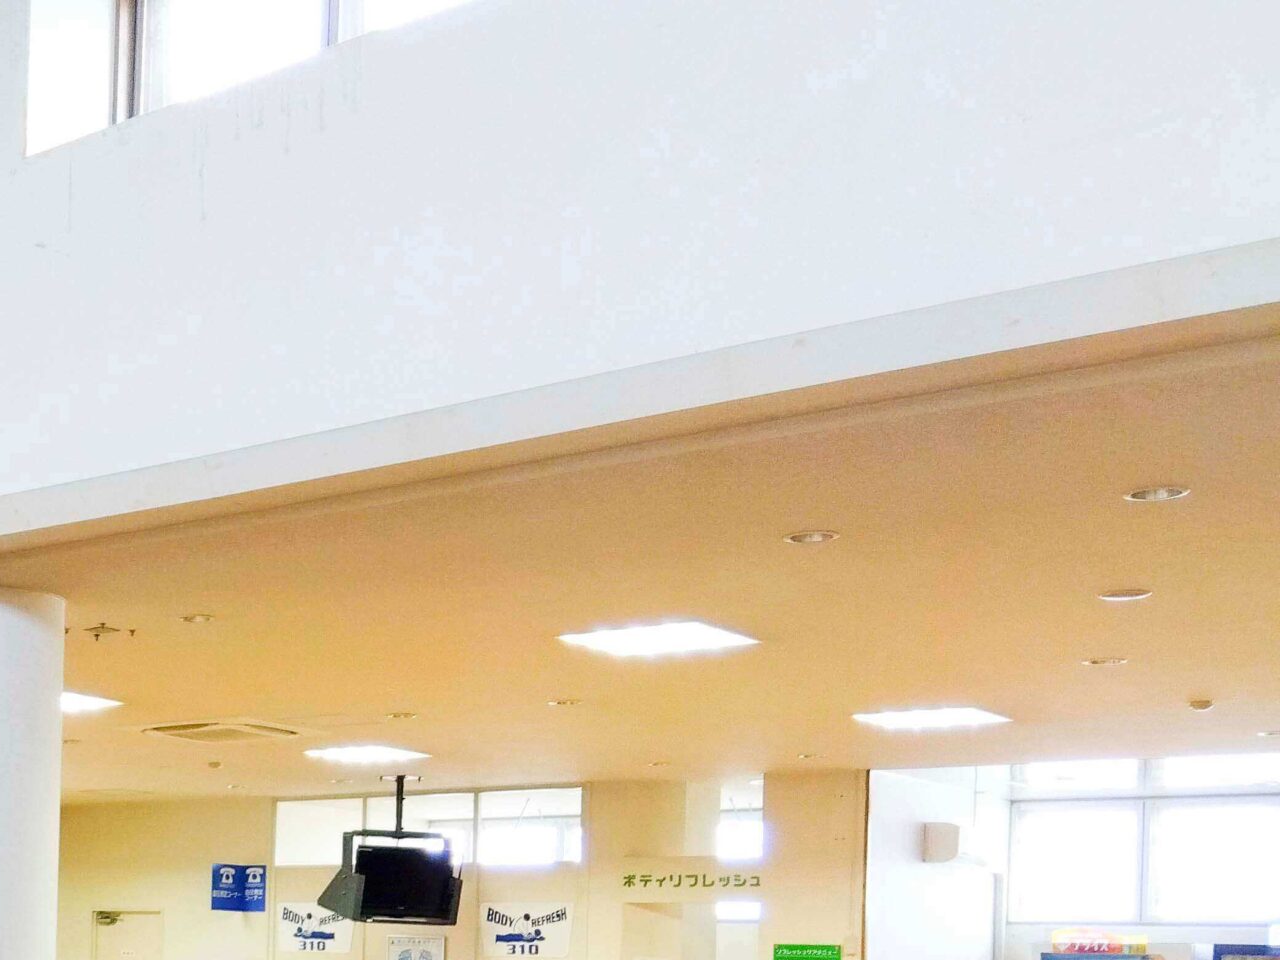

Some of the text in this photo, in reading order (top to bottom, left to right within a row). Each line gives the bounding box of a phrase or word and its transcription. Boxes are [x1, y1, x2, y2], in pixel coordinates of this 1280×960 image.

[282, 907, 306, 926] BODY
[486, 907, 567, 928] BODY REFRESH
[299, 940, 326, 951] 310
[507, 944, 539, 955] 310
